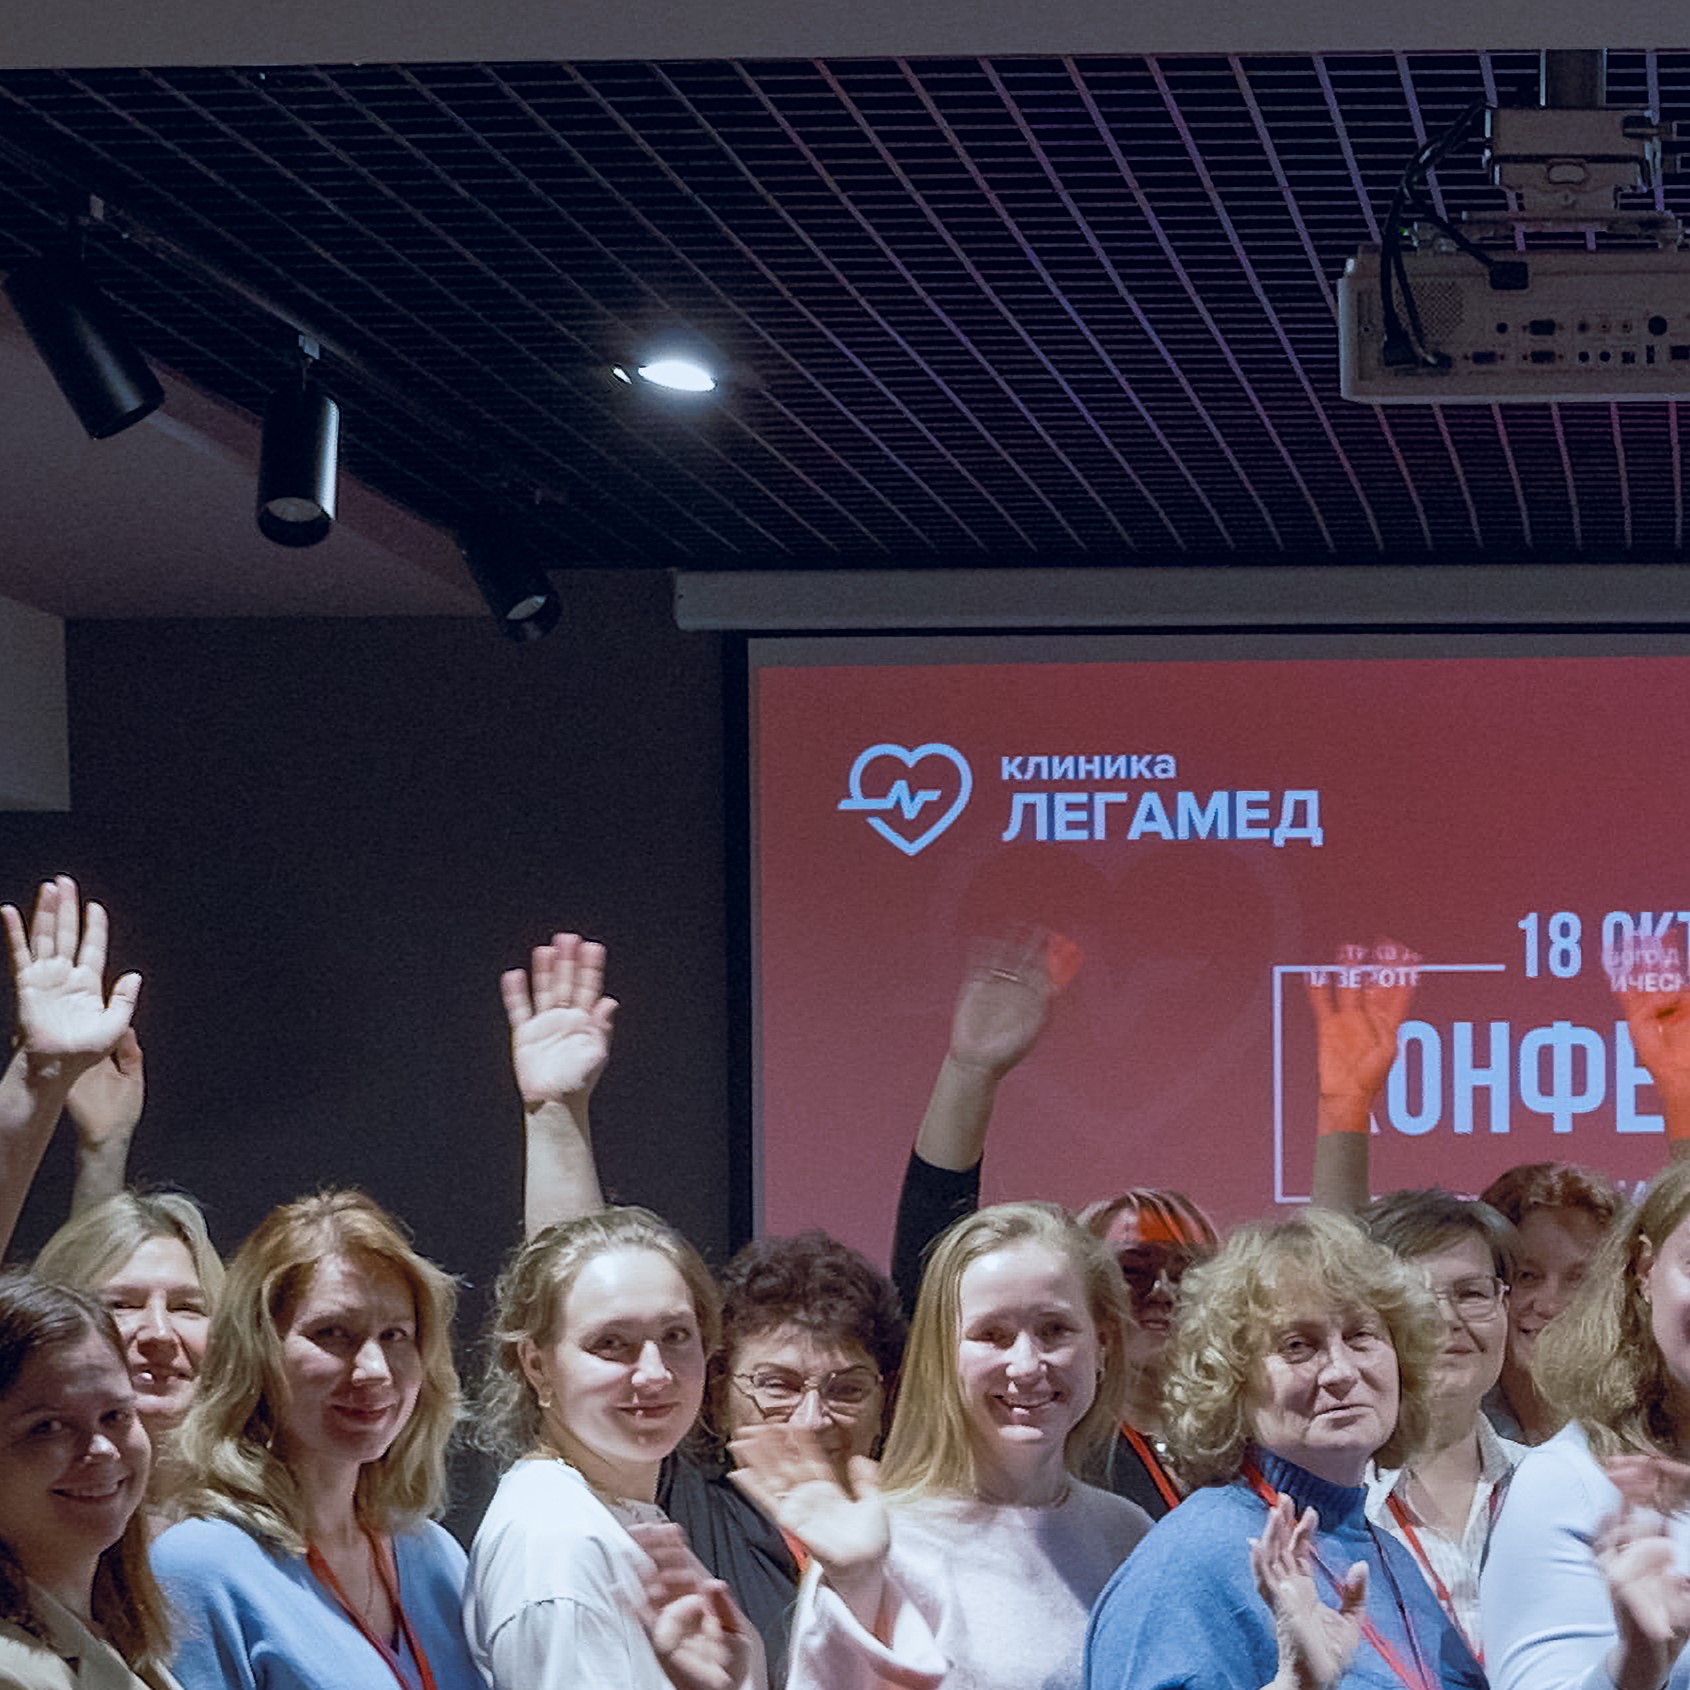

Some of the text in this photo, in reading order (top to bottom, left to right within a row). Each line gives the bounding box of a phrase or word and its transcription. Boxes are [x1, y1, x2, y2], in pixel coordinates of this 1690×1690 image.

[1001, 754, 1177, 781] клиника
[1001, 789, 1325, 848] ЛЕГАМЕД
[1517, 911, 1582, 979] 18
